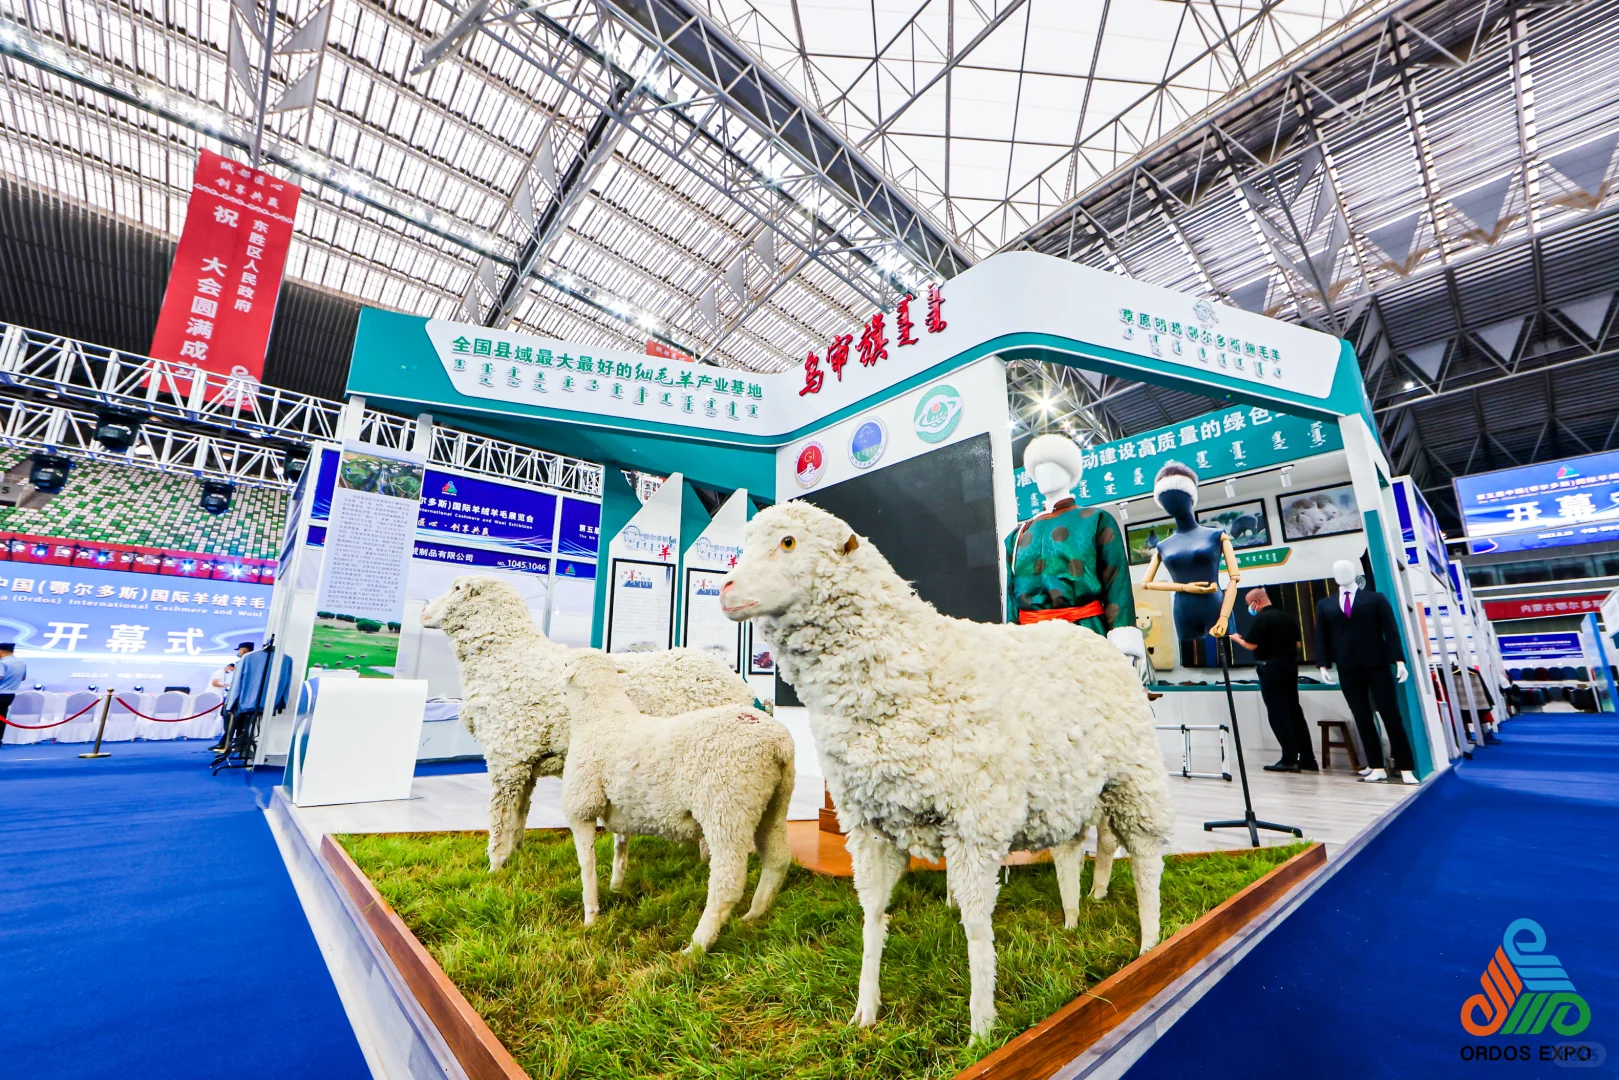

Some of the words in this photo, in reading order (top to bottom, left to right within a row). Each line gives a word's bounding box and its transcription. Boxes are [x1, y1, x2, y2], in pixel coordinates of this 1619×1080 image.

[213, 205, 239, 228] 祝
[234, 219, 269, 313] 东胜区人民政府
[1120, 308, 1281, 362] 草原明珠鄂尔多斯细毛羊
[452, 335, 763, 399] 全国县域最大最好的细毛羊产业基地
[799, 313, 889, 396] 乌审旗
[1082, 406, 1287, 470] 动建设高质量的绿色
[804, 451, 815, 463] GI
[1506, 490, 1619, 522] 开幕
[0, 576, 270, 611] 中国(鄂尔多斯)国际羊绒羊毛
[13, 594, 62, 605] (Ordos)
[69, 598, 148, 610] International
[155, 604, 208, 614] Cashmere
[41, 622, 204, 656] 开幕式
